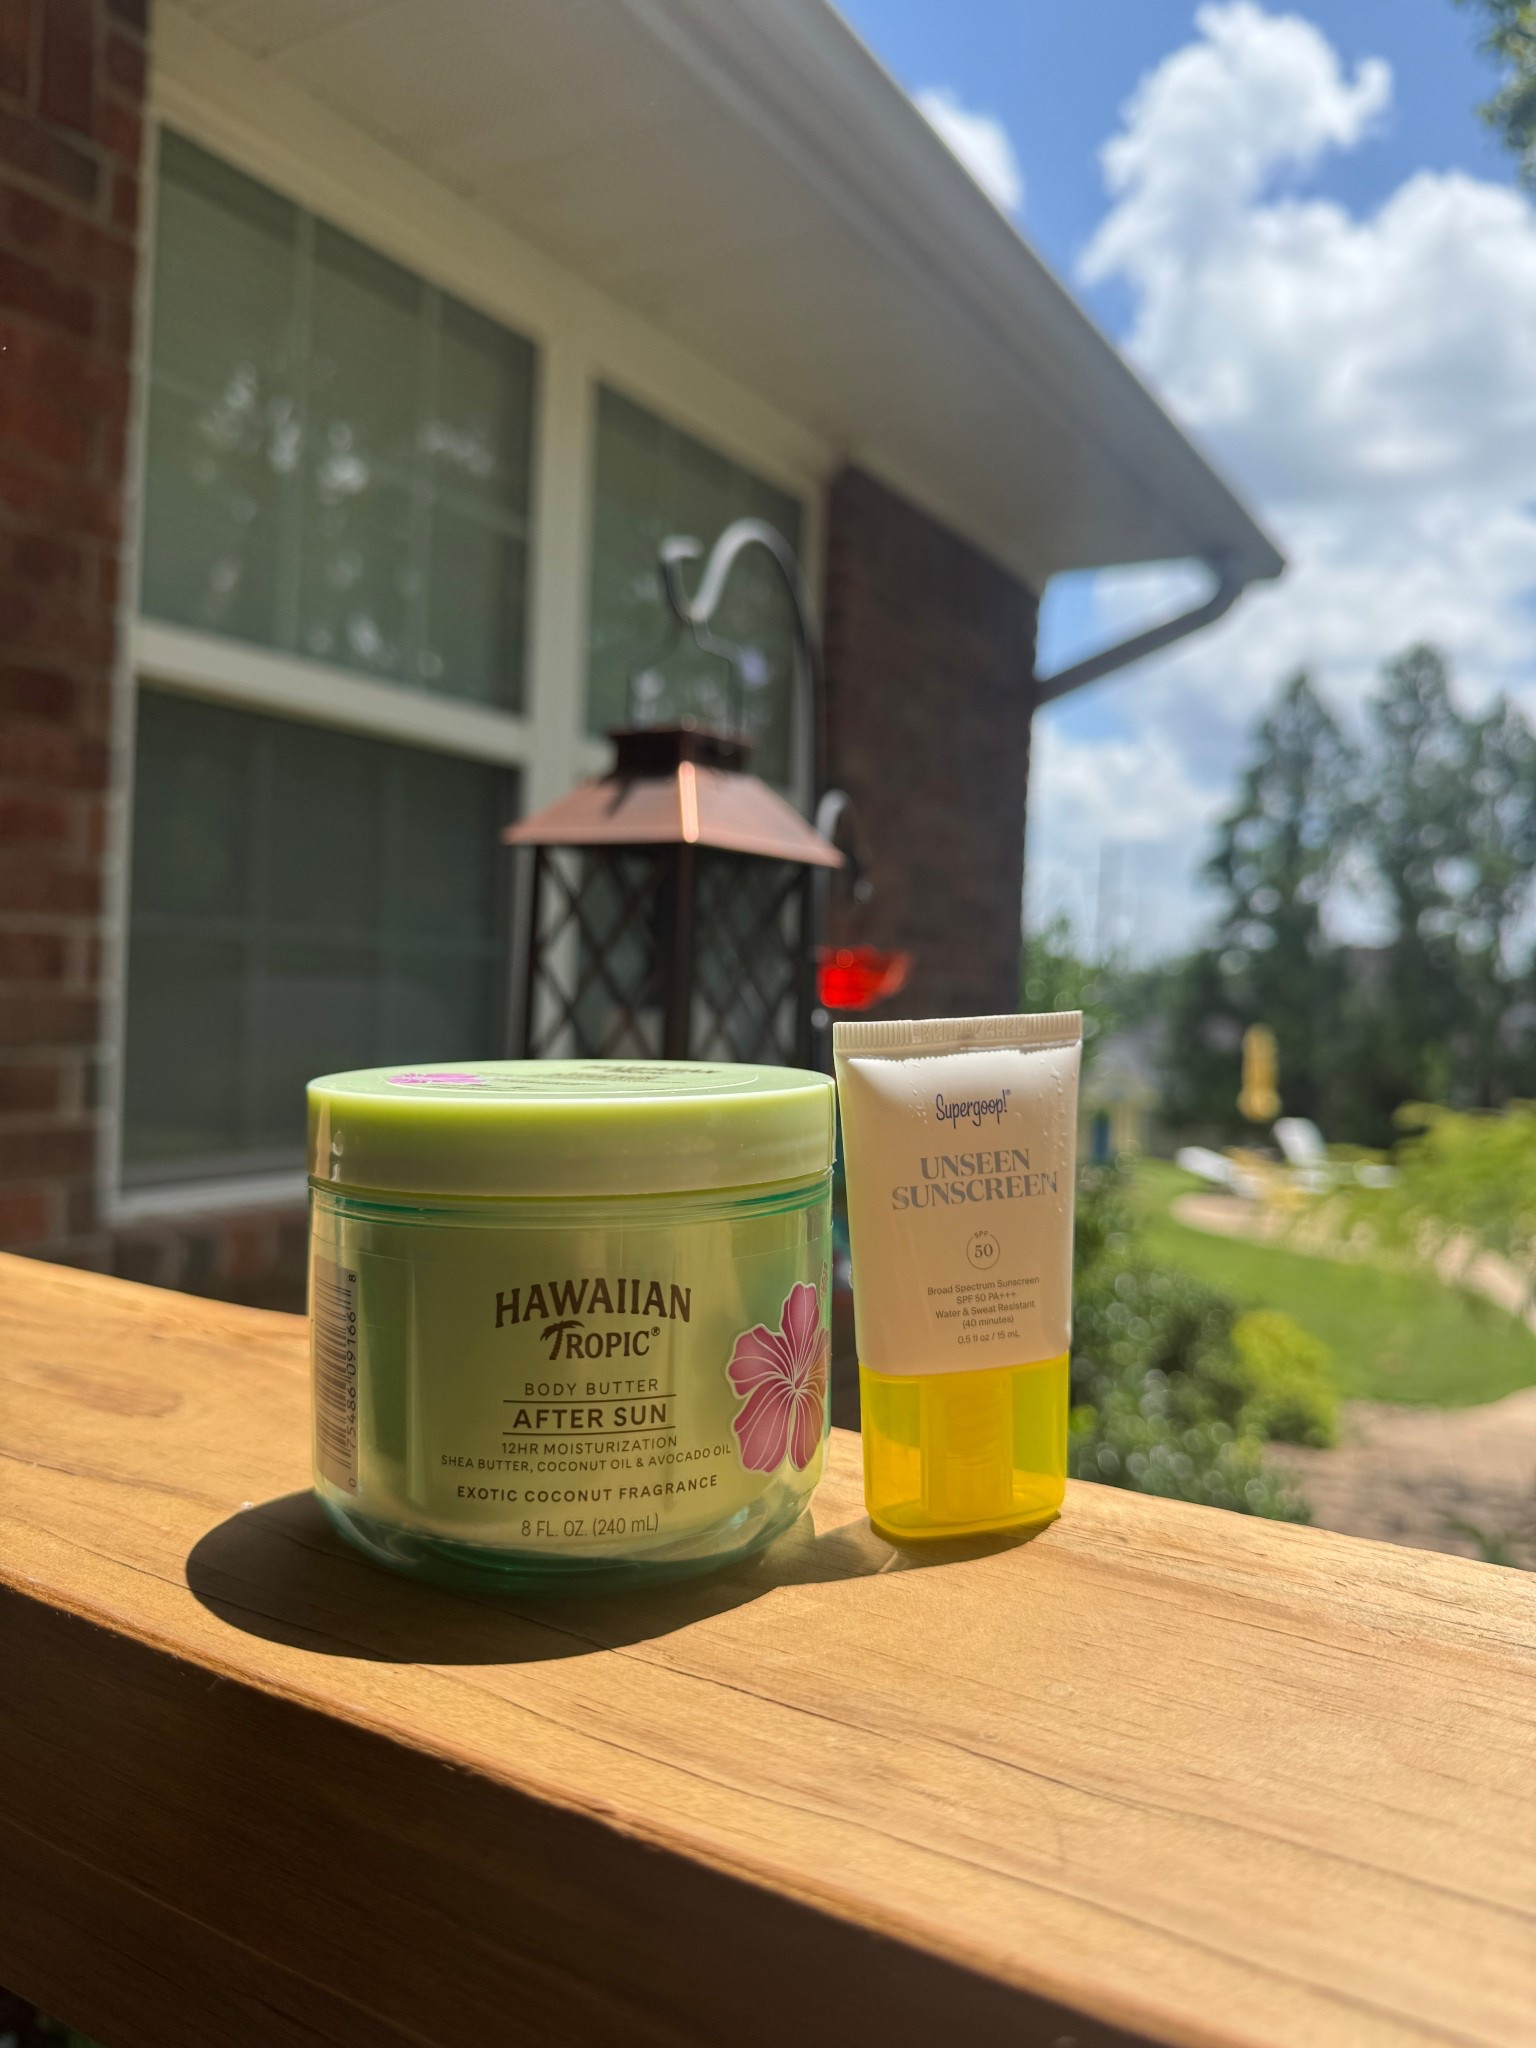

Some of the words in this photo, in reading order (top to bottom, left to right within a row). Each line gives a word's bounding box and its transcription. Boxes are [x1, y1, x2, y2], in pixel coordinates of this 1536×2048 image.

[920, 1148, 1030, 1180] UNSEEN
[892, 1171, 1058, 1211] SUNSCREEN
[974, 1230, 989, 1239] SPF
[974, 1243, 993, 1258] 50
[927, 1286, 953, 1296] Broad
[955, 1282, 996, 1294] Spectrum
[996, 1276, 1040, 1288] Sunscreen
[495, 1277, 692, 1328] HAWAIIAN
[956, 1295, 974, 1305] SPF
[975, 1293, 986, 1303] 50
[988, 1291, 1016, 1301] PA+++
[935, 1309, 960, 1319] Water
[962, 1308, 970, 1316] &
[971, 1305, 996, 1315] Sweat
[998, 1300, 1035, 1312] Resistant
[962, 1318, 977, 1329] (40
[979, 1314, 1014, 1326] minutes)
[957, 1335, 971, 1344] 0.5
[973, 1334, 978, 1343] fl
[980, 1333, 990, 1342] oz
[997, 1330, 1005, 1339] 15
[1007, 1329, 1020, 1338] mL
[524, 1383, 577, 1396] BODY
[586, 1379, 659, 1395] BUTTER
[512, 1408, 604, 1429] AFTER
[613, 1404, 667, 1426] SUN
[502, 1442, 539, 1455] 12HR
[544, 1435, 677, 1455] MOISTURIZATION
[441, 1454, 474, 1468] SHEA
[478, 1458, 534, 1474] BUTTER,
[537, 1460, 607, 1472] COCONUT
[610, 1458, 632, 1469] OIL
[636, 1457, 644, 1468] &
[649, 1447, 711, 1466] AVOCADO
[713, 1443, 731, 1456] OIL
[457, 1485, 517, 1501] EXOTIC
[524, 1489, 612, 1502] COCONUT
[619, 1475, 718, 1499] FRAGRANCE
[521, 1520, 531, 1537] 8
[537, 1520, 559, 1537] FL.
[563, 1520, 587, 1537] OZ.
[593, 1517, 626, 1537] (240
[631, 1512, 659, 1533] mL)
